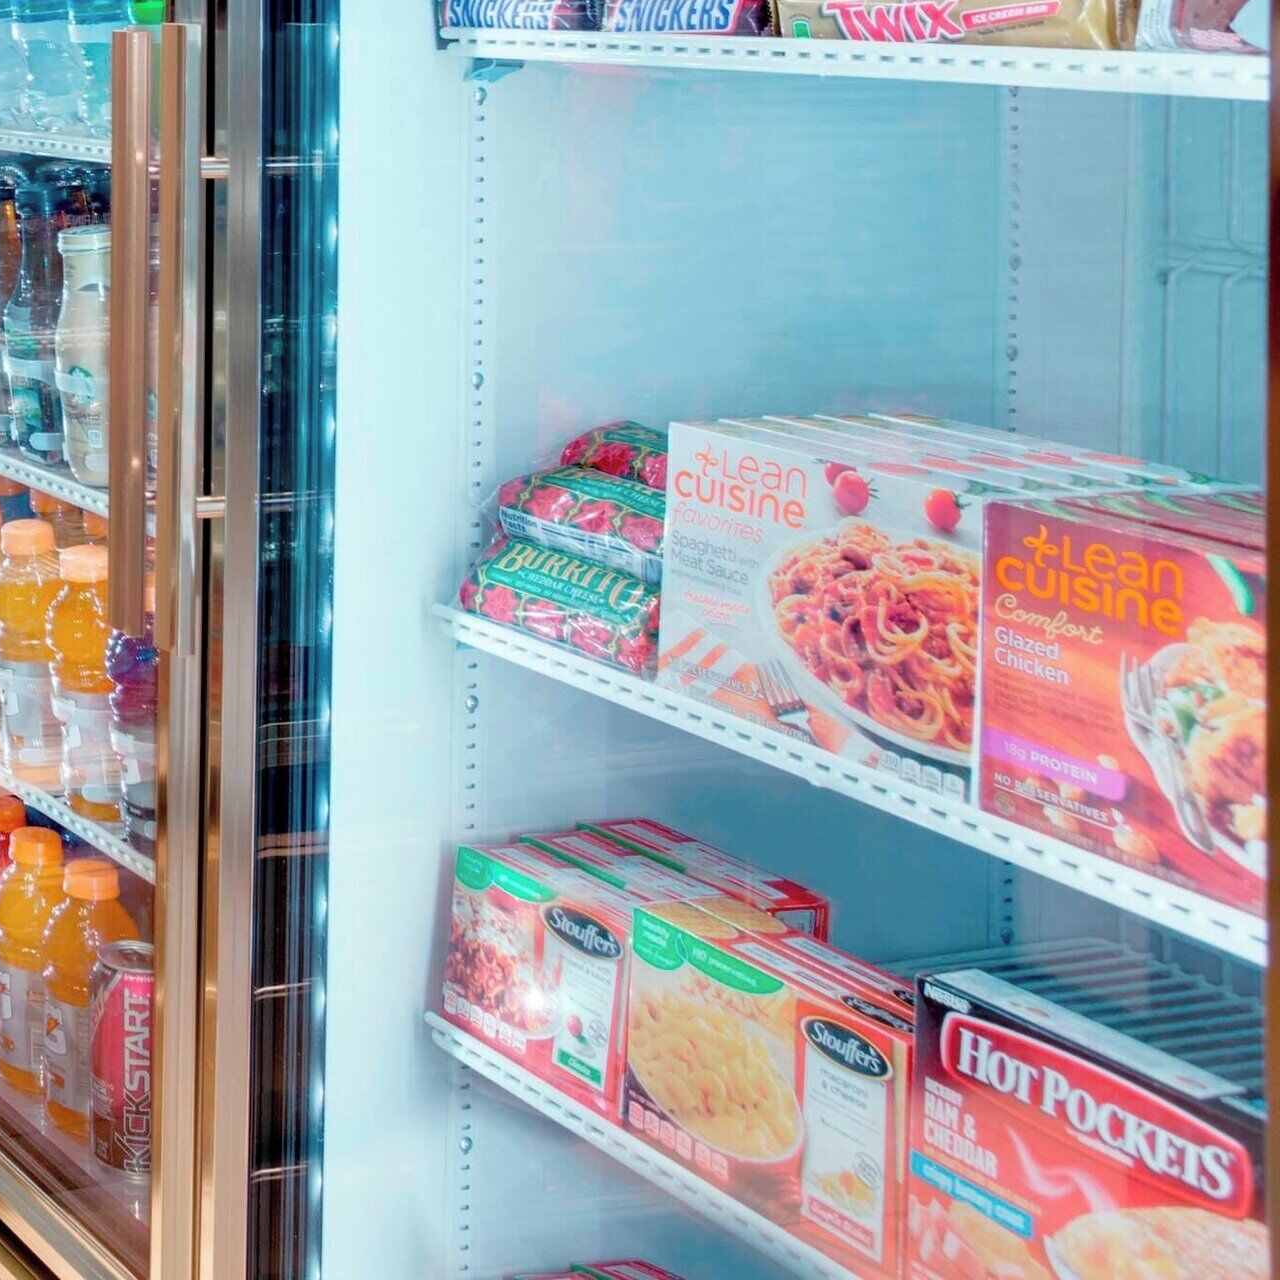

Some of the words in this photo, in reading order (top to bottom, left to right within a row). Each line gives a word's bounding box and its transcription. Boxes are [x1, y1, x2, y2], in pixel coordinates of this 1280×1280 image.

[721, 450, 807, 498] Lean
[501, 508, 538, 529] Nutrition
[670, 501, 765, 545] favorites
[670, 548, 703, 573] Meat
[707, 558, 749, 586] Sauce
[671, 530, 737, 562] Spaghetti
[737, 554, 760, 569] with
[1061, 535, 1184, 601] Lean
[494, 543, 647, 612] BURRITO
[993, 625, 1060, 661] Glazed
[994, 593, 1104, 645] Comfort
[994, 646, 1070, 685] Chicken
[1003, 740, 1027, 762] 18g
[1029, 744, 1099, 786] PROTEIN
[994, 771, 1011, 786] NO
[1015, 778, 1110, 824] PRESERVATIVES
[549, 907, 618, 957] Stouffer's
[811, 1022, 882, 1076] Stouffer's
[123, 987, 152, 1177] KICKSTART
[820, 1068, 870, 1100] macaroni
[828, 1085, 868, 1111] cheese
[924, 1092, 960, 1135] HAM
[963, 1114, 977, 1141] &
[956, 1026, 1040, 1106] HOT
[1040, 1065, 1234, 1201] POCKETS
[924, 1118, 998, 1180] CHEDDAR
